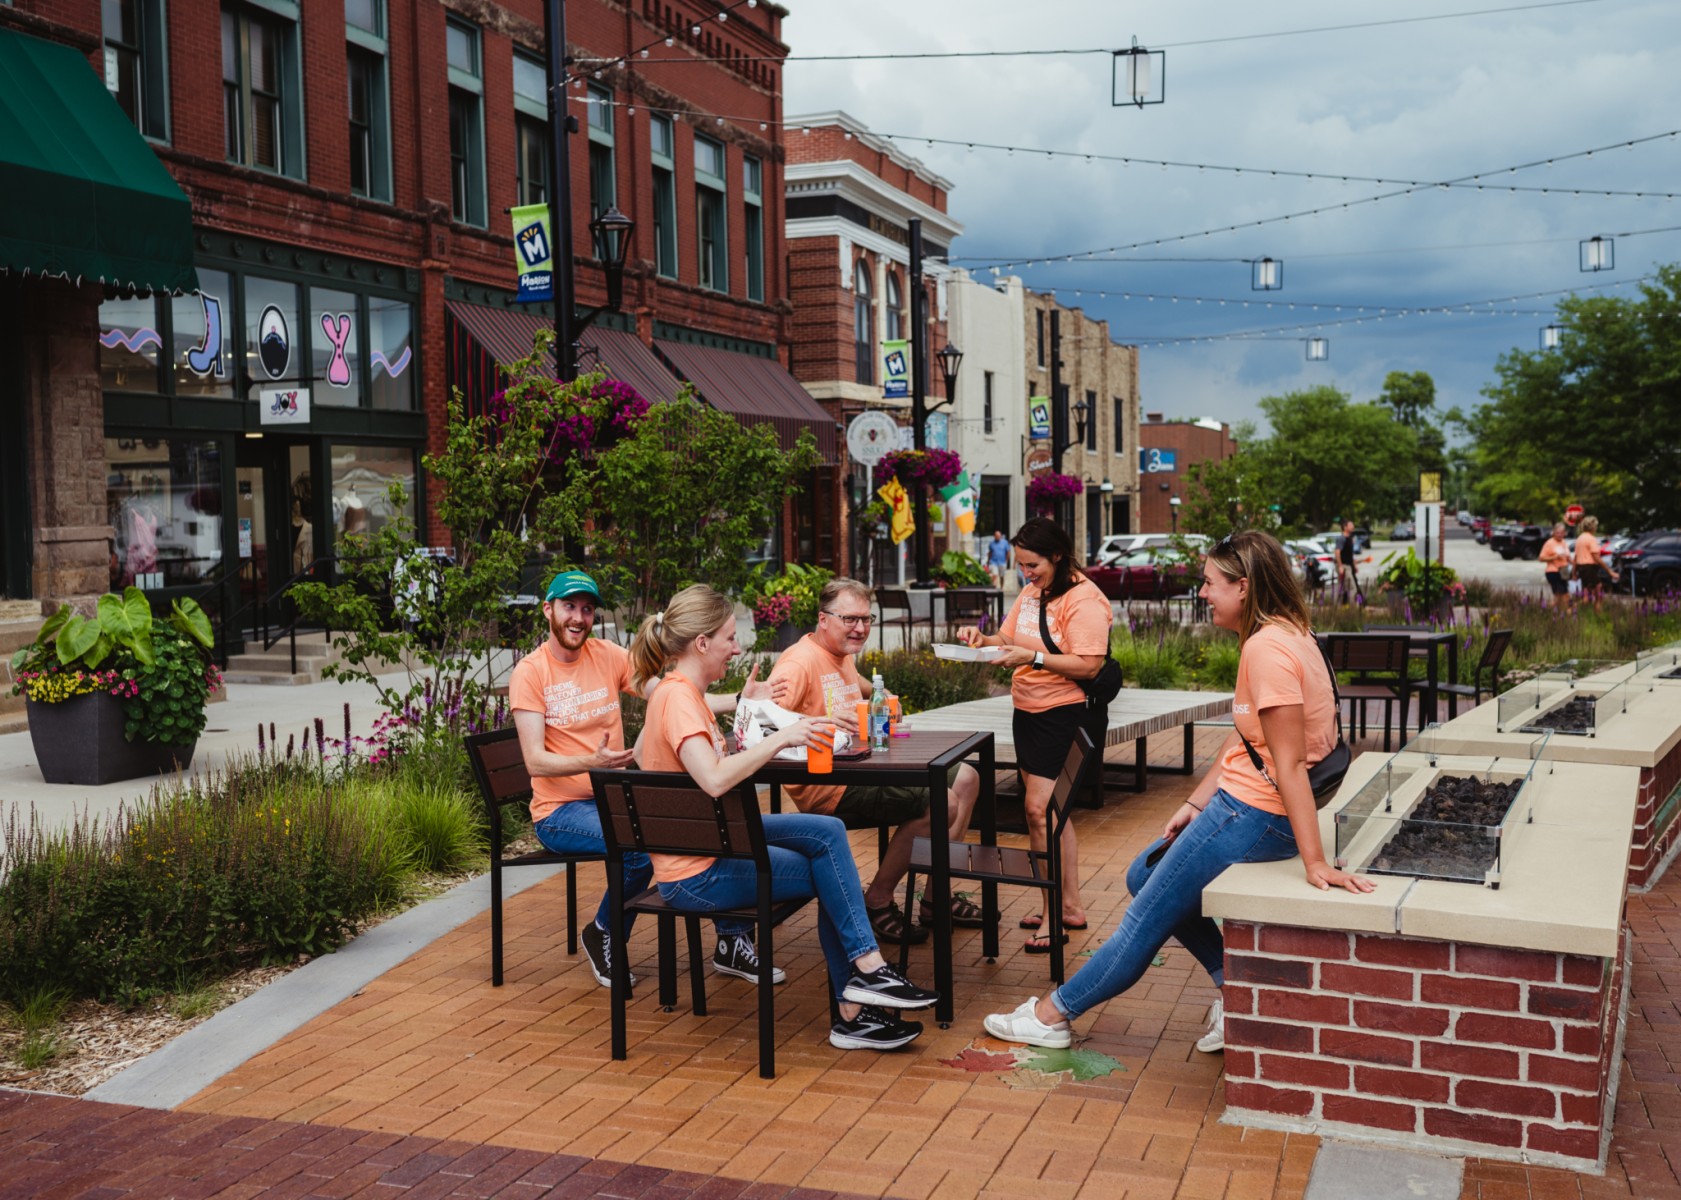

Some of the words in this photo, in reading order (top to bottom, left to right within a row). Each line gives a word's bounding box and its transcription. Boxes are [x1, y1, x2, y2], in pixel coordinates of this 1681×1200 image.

[524, 234, 546, 262] M
[271, 391, 298, 411] JOY
[544, 680, 574, 696] EXREME
[571, 711, 589, 723] THAT
